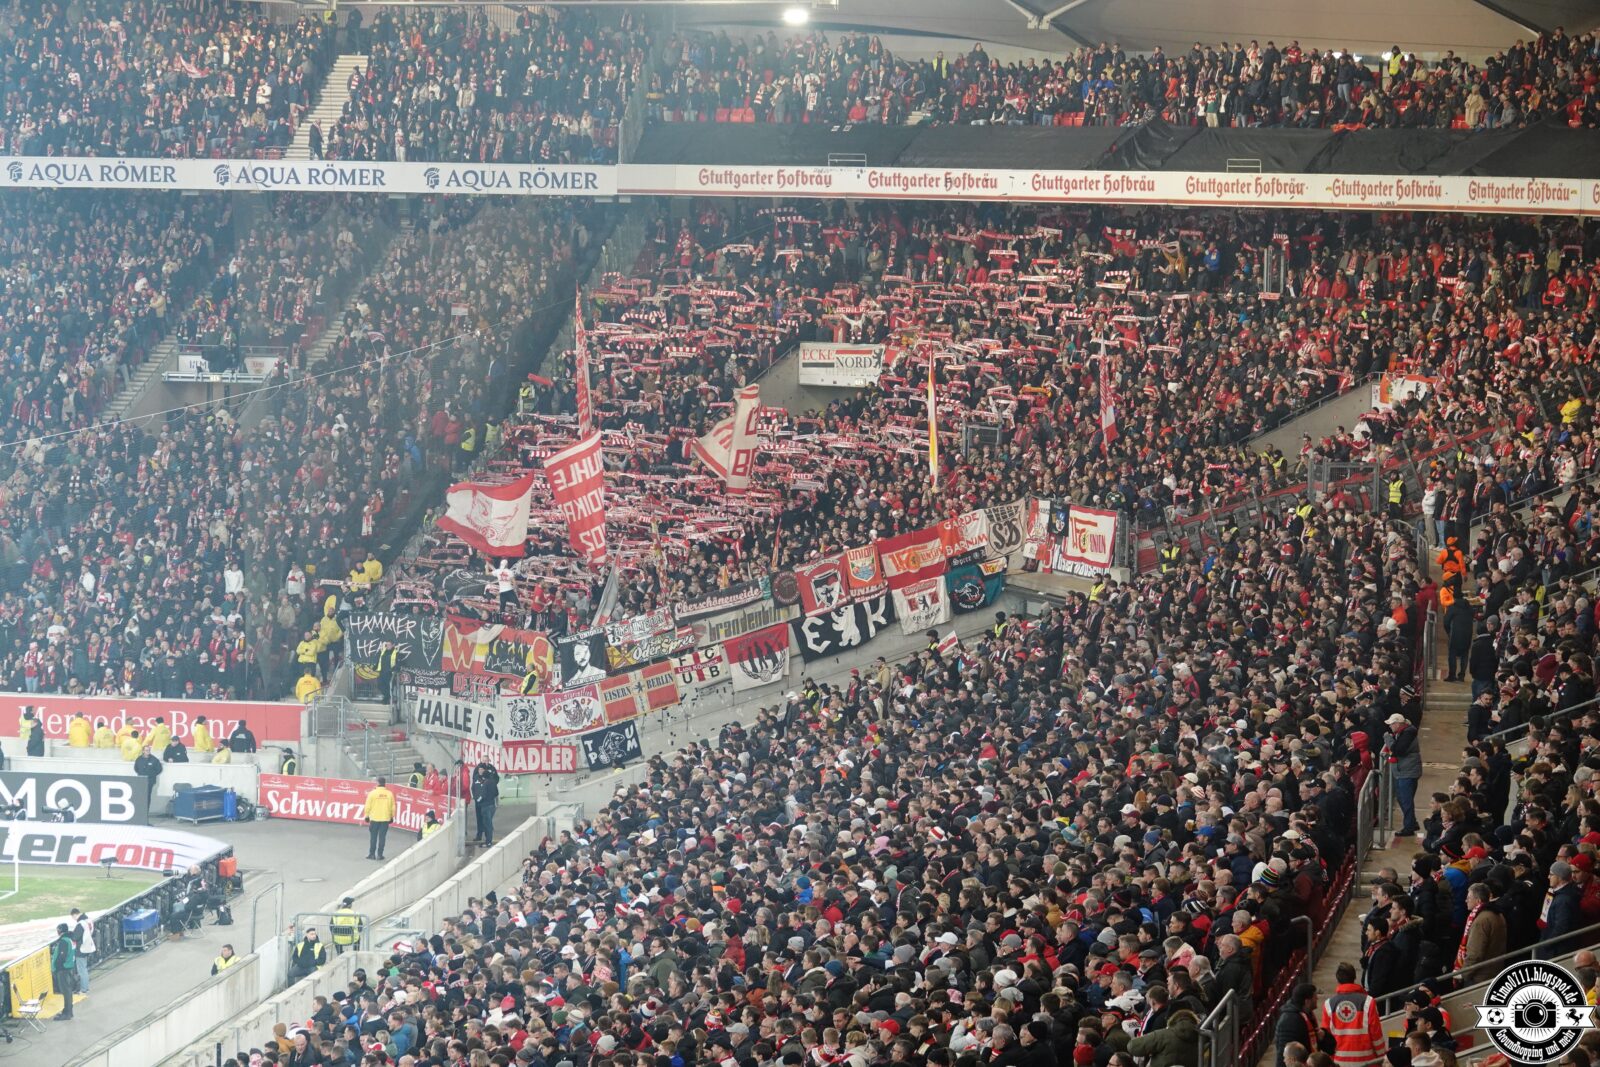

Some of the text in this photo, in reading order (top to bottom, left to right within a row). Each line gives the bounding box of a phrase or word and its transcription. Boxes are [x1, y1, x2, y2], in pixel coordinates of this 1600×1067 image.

[28, 160, 177, 185] AQUA RÖMER
[236, 164, 386, 187] AQUA RÖMER
[446, 167, 599, 191] AQUA RÖMER
[699, 167, 832, 188] Stuttgarter Hofbräu
[868, 170, 997, 191] Stuttgarter Hofbräu
[1032, 173, 1155, 195] Stuttgarter Hofbräu
[1185, 175, 1306, 198] Stuttgarter Hofbräu
[1332, 178, 1441, 201] Stuttgarter Hofbräu
[1468, 180, 1526, 203] Stuttgarter
[1528, 181, 1570, 204] Hofbräu
[802, 349, 835, 361] ECKE
[836, 356, 873, 369] NORD
[944, 512, 979, 530] GARDE
[848, 547, 874, 561] UNION
[945, 533, 988, 556] BARNIM
[675, 586, 762, 617] Oberschöneweide
[350, 613, 417, 640] HAMMER
[604, 683, 632, 702] EISERN
[646, 672, 674, 690] BERLIN
[418, 699, 473, 733] HALLE
[485, 713, 499, 741] S.
[463, 740, 574, 771] SACHSENADLER
